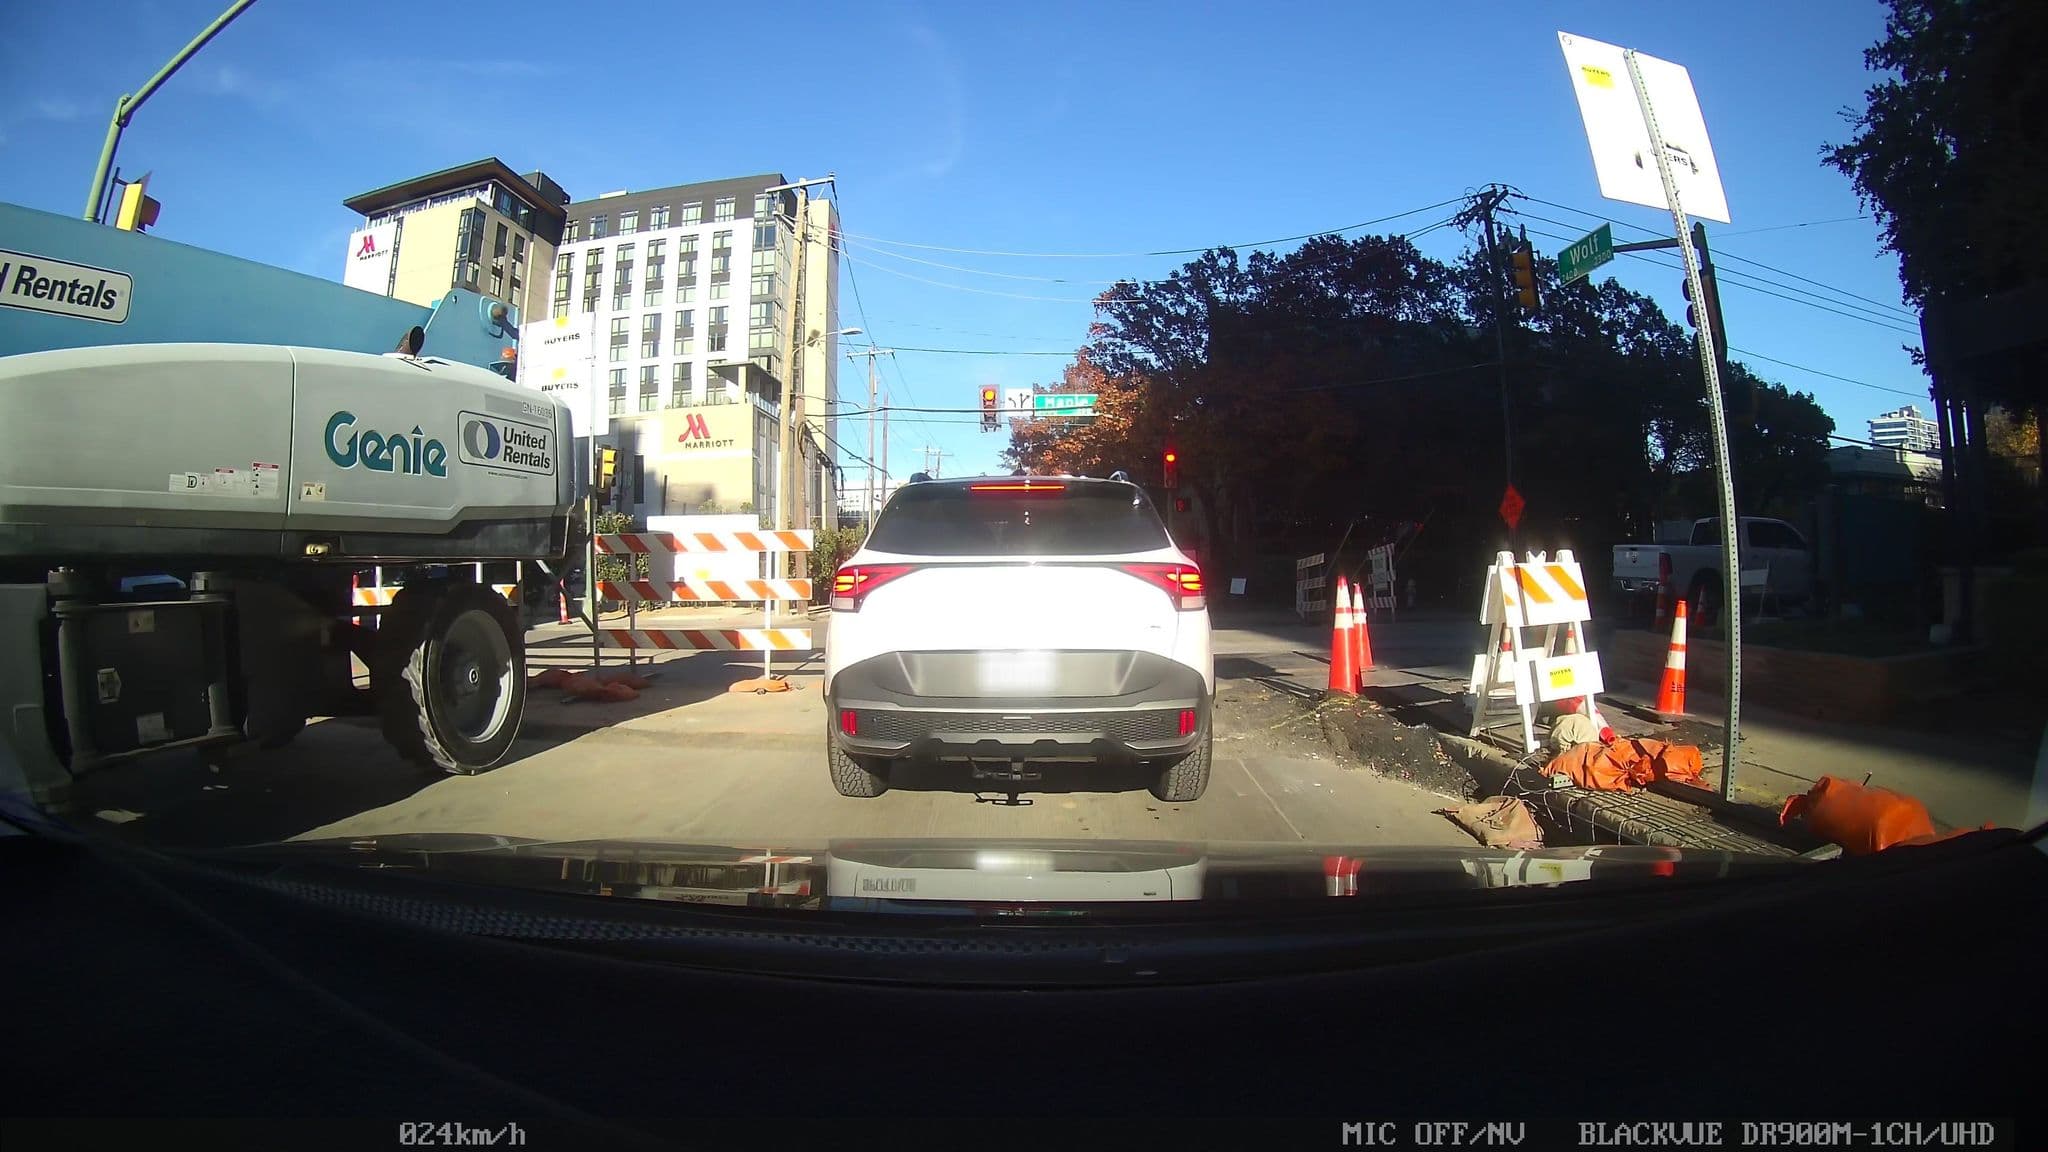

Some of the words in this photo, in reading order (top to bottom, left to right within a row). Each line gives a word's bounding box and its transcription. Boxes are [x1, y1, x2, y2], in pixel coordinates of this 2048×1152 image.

[1570, 233, 1599, 265] Wolf
[11, 264, 118, 310] Rentals
[324, 410, 448, 479] Genie
[503, 426, 547, 450] United
[685, 439, 735, 449] MARRIOTT
[502, 445, 552, 469] Rentals
